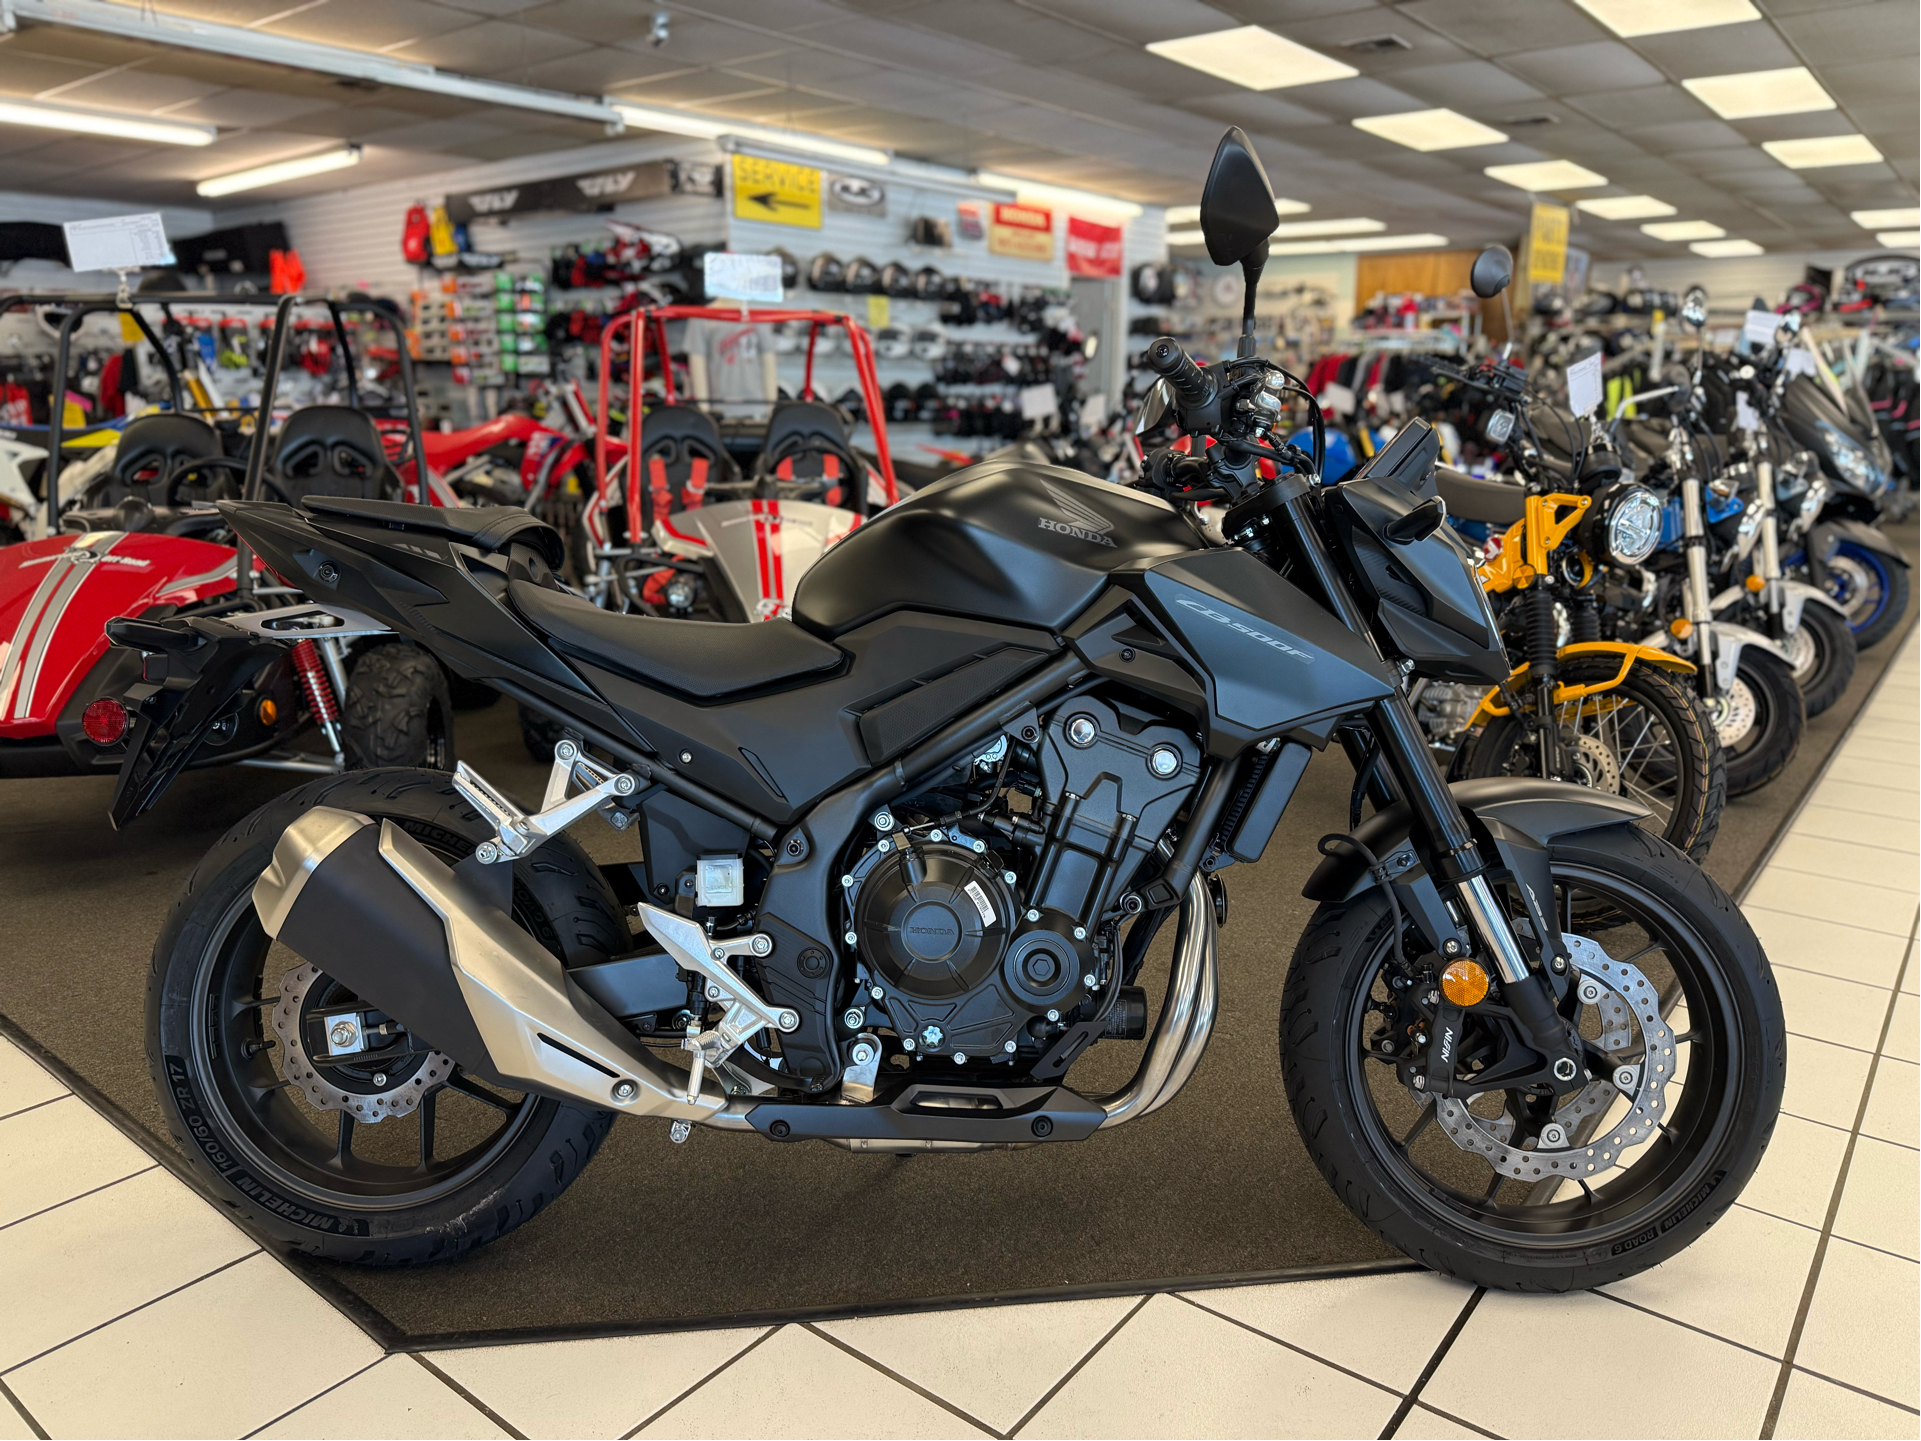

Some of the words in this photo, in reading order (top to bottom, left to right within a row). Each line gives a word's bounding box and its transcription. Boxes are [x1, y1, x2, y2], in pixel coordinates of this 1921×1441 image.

[737, 156, 818, 195] SERVICE
[1038, 518, 1118, 548] HONDA
[1175, 599, 1314, 659] CB500F
[403, 821, 474, 853] MICHE
[909, 926, 955, 936] HONDA
[169, 1062, 187, 1083] 17
[176, 1086, 194, 1110] ZR
[188, 1115, 232, 1170] 160/60
[236, 1175, 334, 1230] MICHELIN
[1664, 1184, 1710, 1230] MICHELIN
[1614, 1245, 1622, 1254] 6
[1625, 1231, 1655, 1250] ROAD
